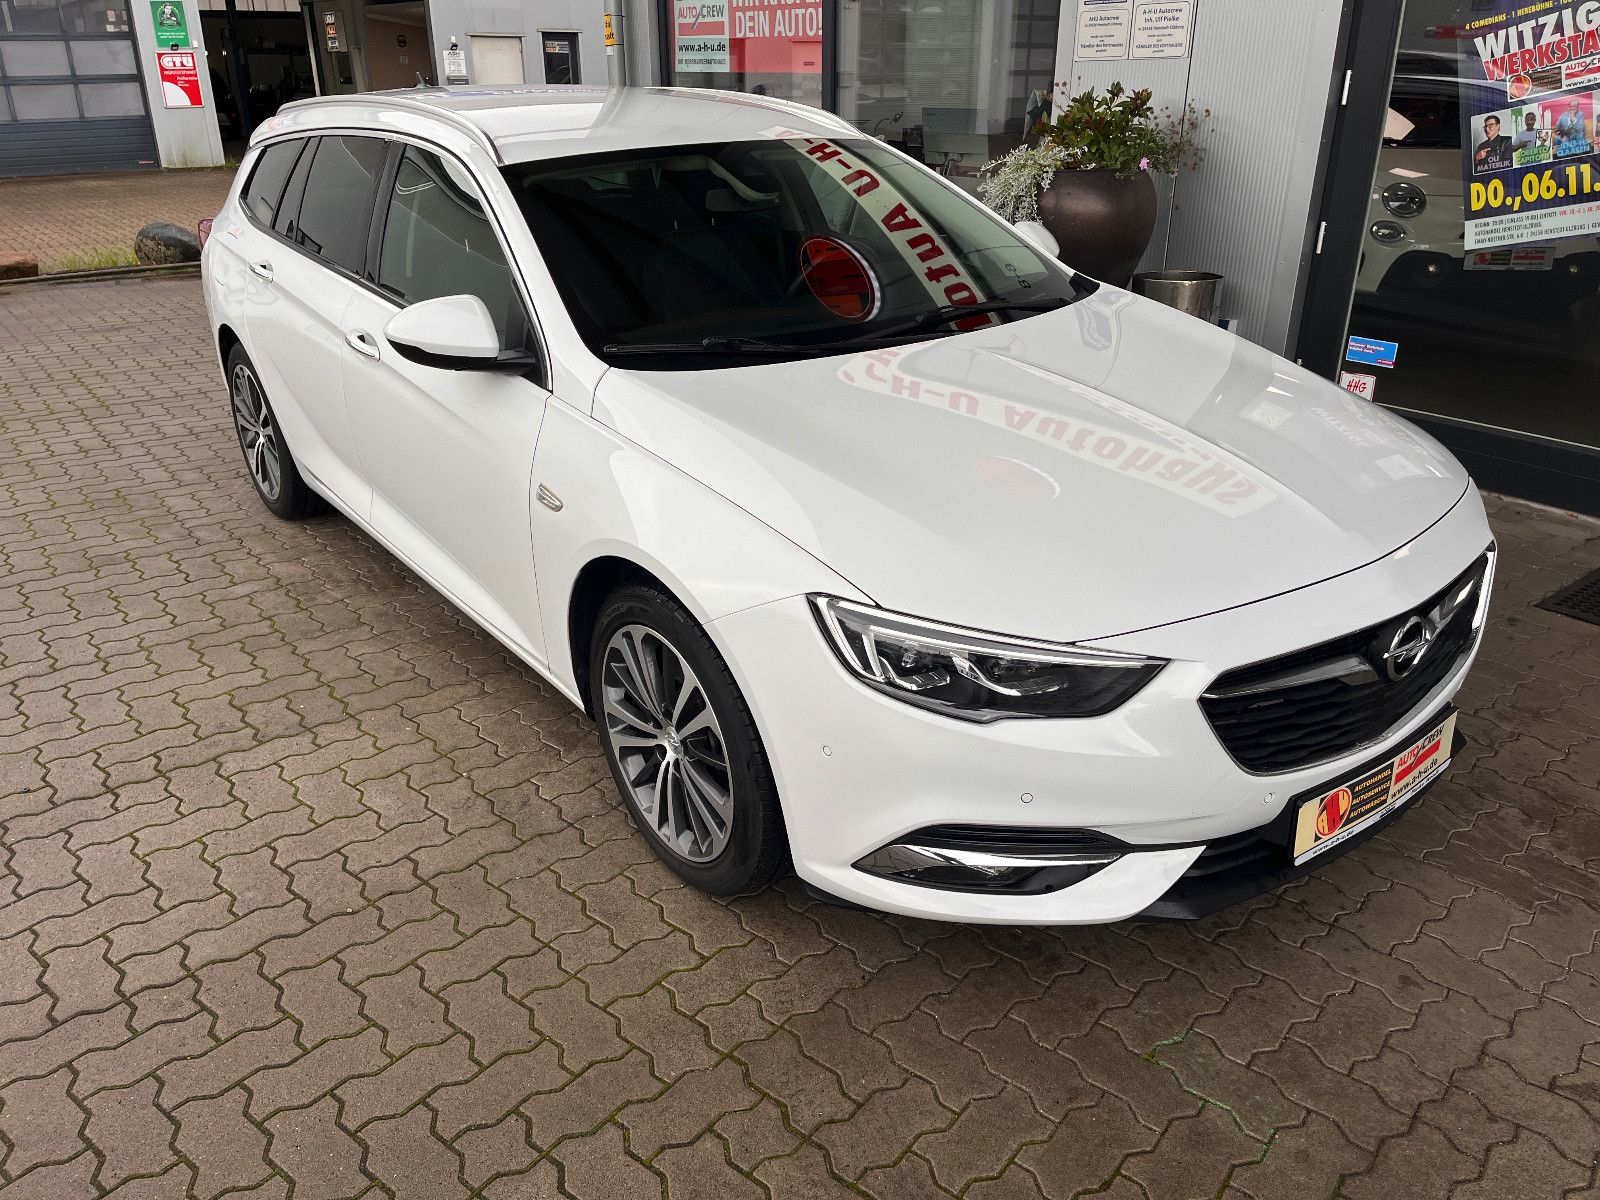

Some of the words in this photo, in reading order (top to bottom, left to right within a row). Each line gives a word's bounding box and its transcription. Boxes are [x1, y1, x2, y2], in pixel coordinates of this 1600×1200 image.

[677, 6, 698, 19] AUTO
[700, 4, 725, 18] CREW
[735, 10, 770, 38] DEIN
[774, 7, 822, 37] AUTO!
[1471, 13, 1506, 29] COMEDIANS
[1517, 0, 1553, 16] HEBEBÜHNE
[678, 41, 726, 52] www.a-h-u.de
[1483, 28, 1600, 82] WERKSTA
[161, 53, 194, 68] GTÜ
[1565, 60, 1588, 71] AUTO
[1476, 160, 1511, 172] MATERLIK
[1488, 155, 1500, 163] OLI
[1396, 745, 1420, 770] AUTO
[1422, 723, 1445, 749] CREW
[1354, 769, 1392, 793] AUTOHANDEL
[1390, 758, 1438, 799] www.a-h-u.de
[1352, 781, 1391, 805] AUTOSERVICE
[1350, 793, 1388, 818] AUTOWÄSCHE
